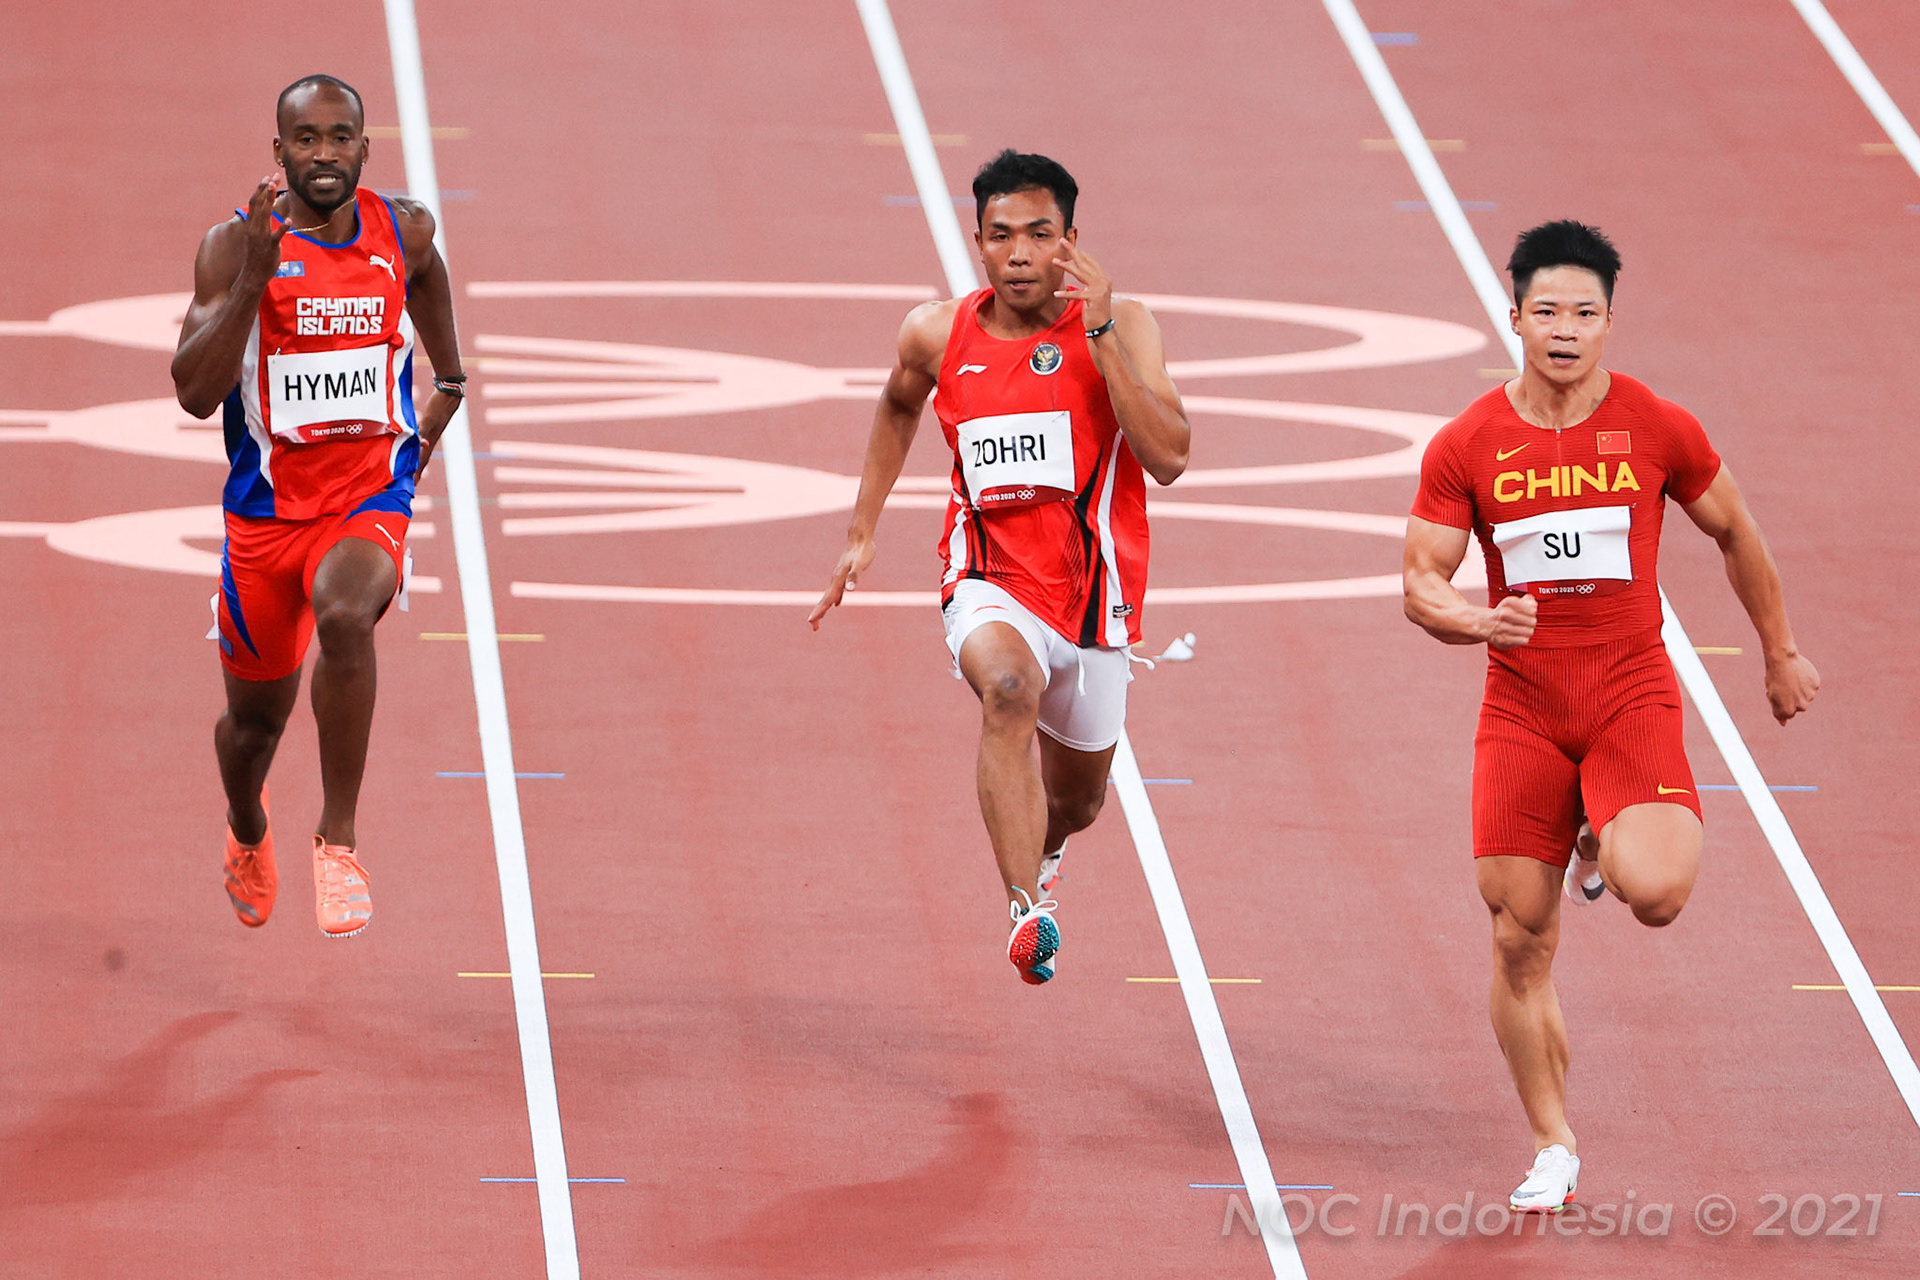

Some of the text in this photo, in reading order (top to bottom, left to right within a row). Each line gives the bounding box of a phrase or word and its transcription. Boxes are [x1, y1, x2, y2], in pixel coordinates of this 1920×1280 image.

[296, 296, 385, 316] CAYMAN
[296, 316, 383, 336] ISLANDS
[284, 367, 377, 402] HYMAN
[311, 427, 345, 436] TOKYO 2020
[972, 434, 1046, 468] ZOHRI
[1493, 461, 1641, 503] CHINA
[1543, 531, 1581, 560] SU
[1538, 586, 1575, 595] TOKYO 2020
